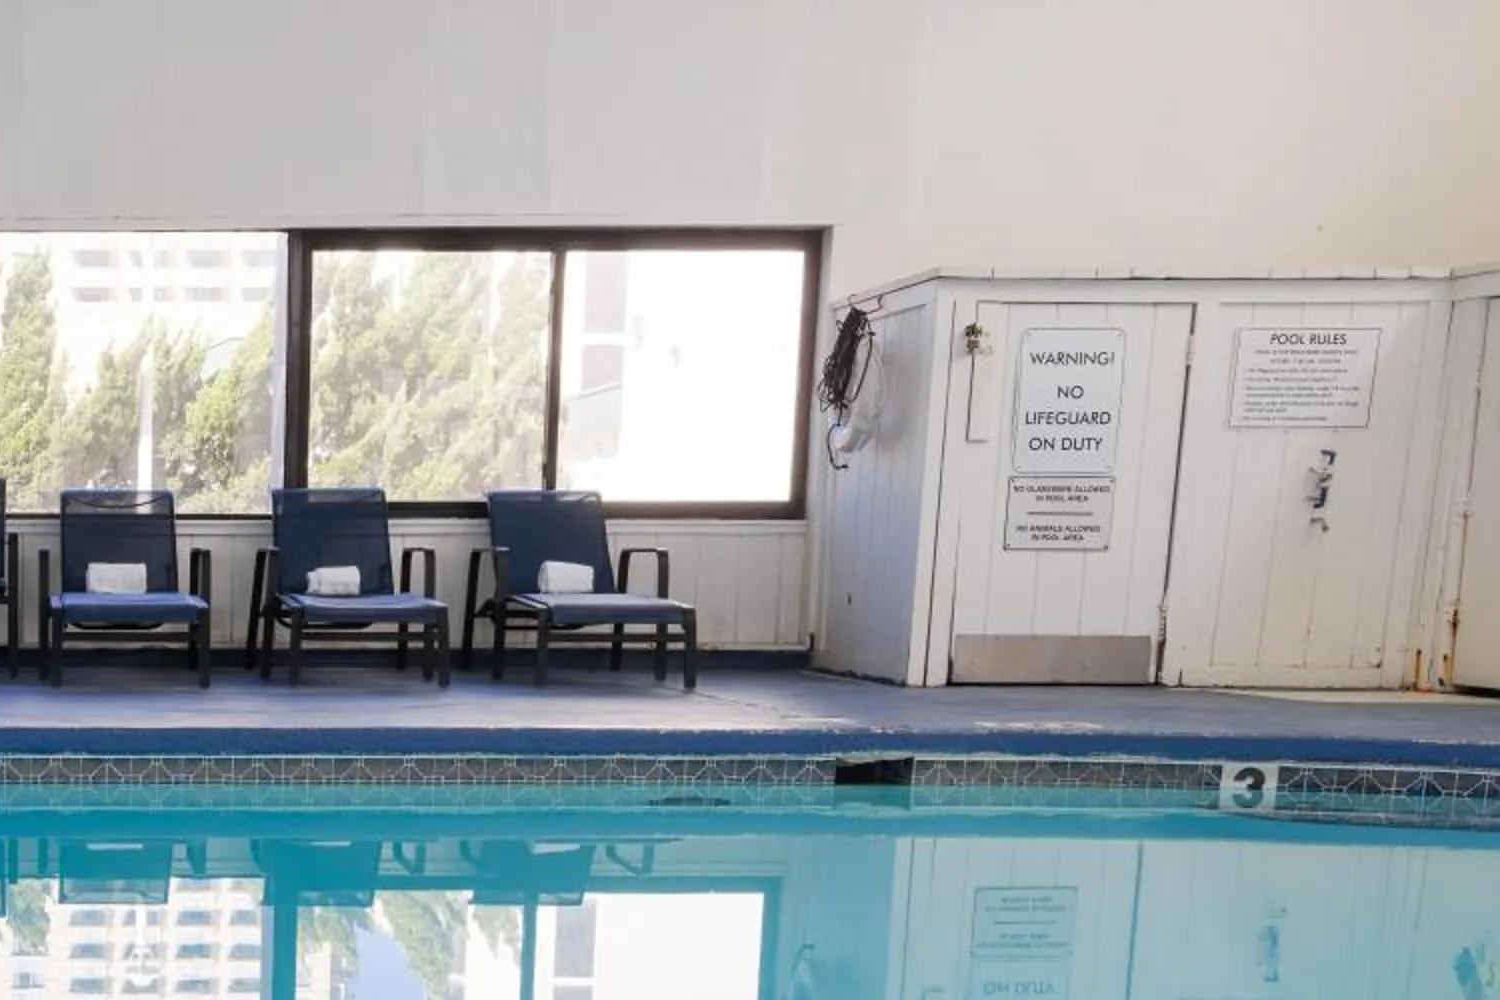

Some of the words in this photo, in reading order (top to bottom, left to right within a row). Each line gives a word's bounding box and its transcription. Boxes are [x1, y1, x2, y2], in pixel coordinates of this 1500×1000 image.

[1269, 333, 1306, 345] POOL
[1309, 333, 1348, 345] RULES
[1029, 351, 1115, 366] WARNING!
[1056, 385, 1085, 400] NO
[1025, 411, 1112, 426] LIFEGUARD
[1028, 436, 1056, 452] ON
[1060, 436, 1104, 452] DUTY
[1233, 766, 1265, 808] 3
